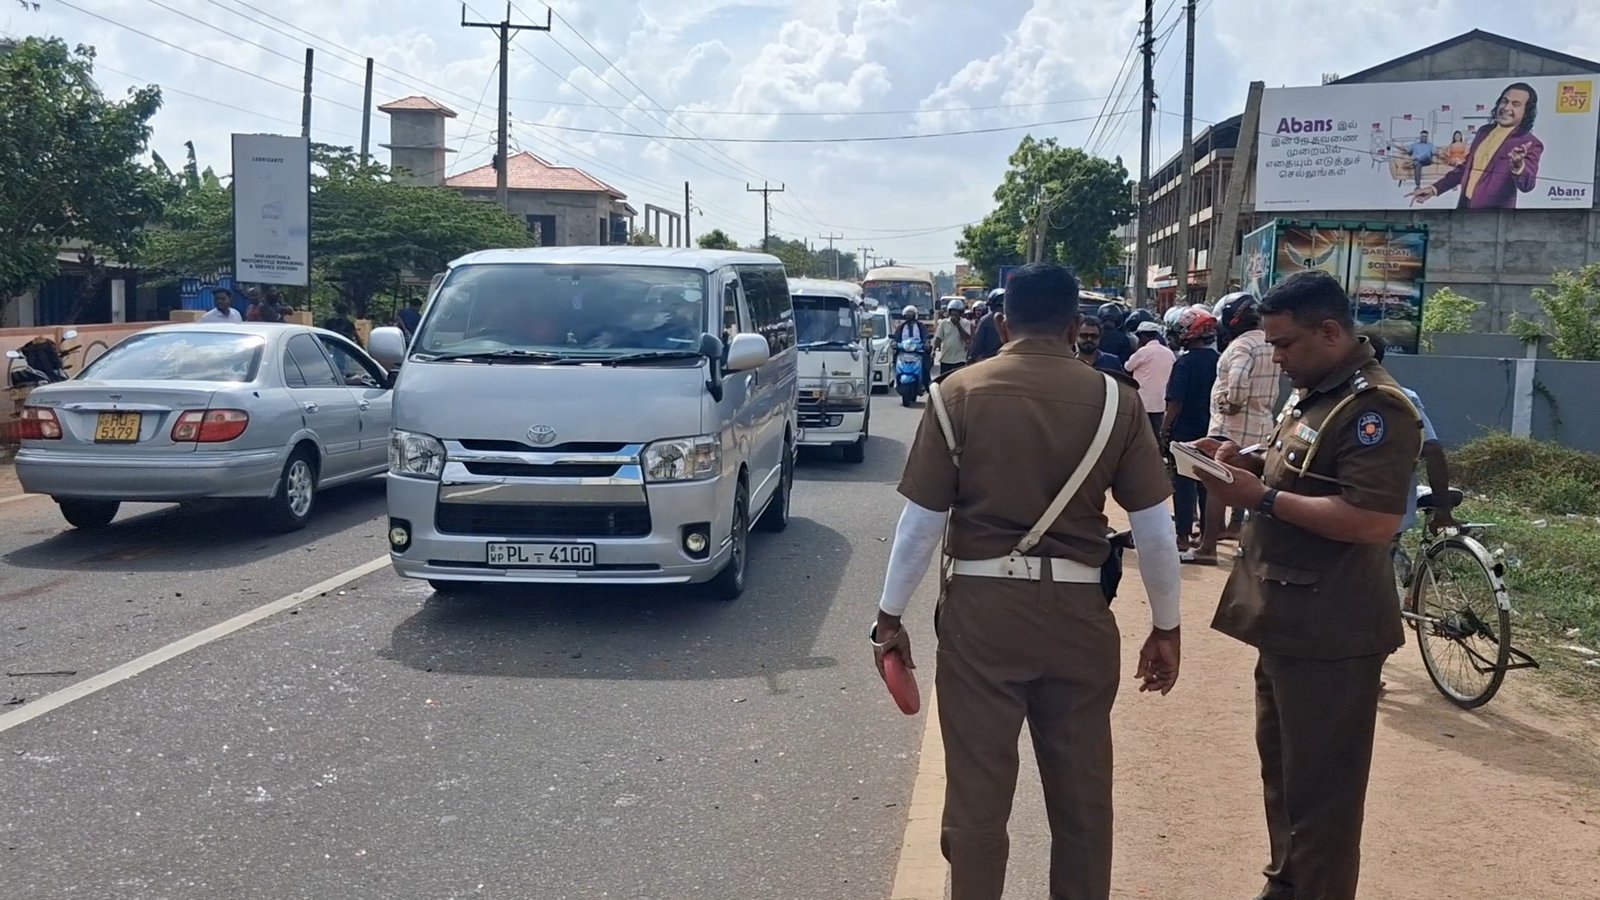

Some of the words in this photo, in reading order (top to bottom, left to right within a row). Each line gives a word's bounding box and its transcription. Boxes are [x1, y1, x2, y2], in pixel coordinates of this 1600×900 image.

[1560, 96, 1587, 109] Pay
[1276, 117, 1333, 134] Abans
[1547, 186, 1586, 197] Abans
[101, 427, 133, 438] 5179
[490, 553, 504, 562] WP
[507, 546, 528, 562] PL
[549, 546, 591, 563] 4100
